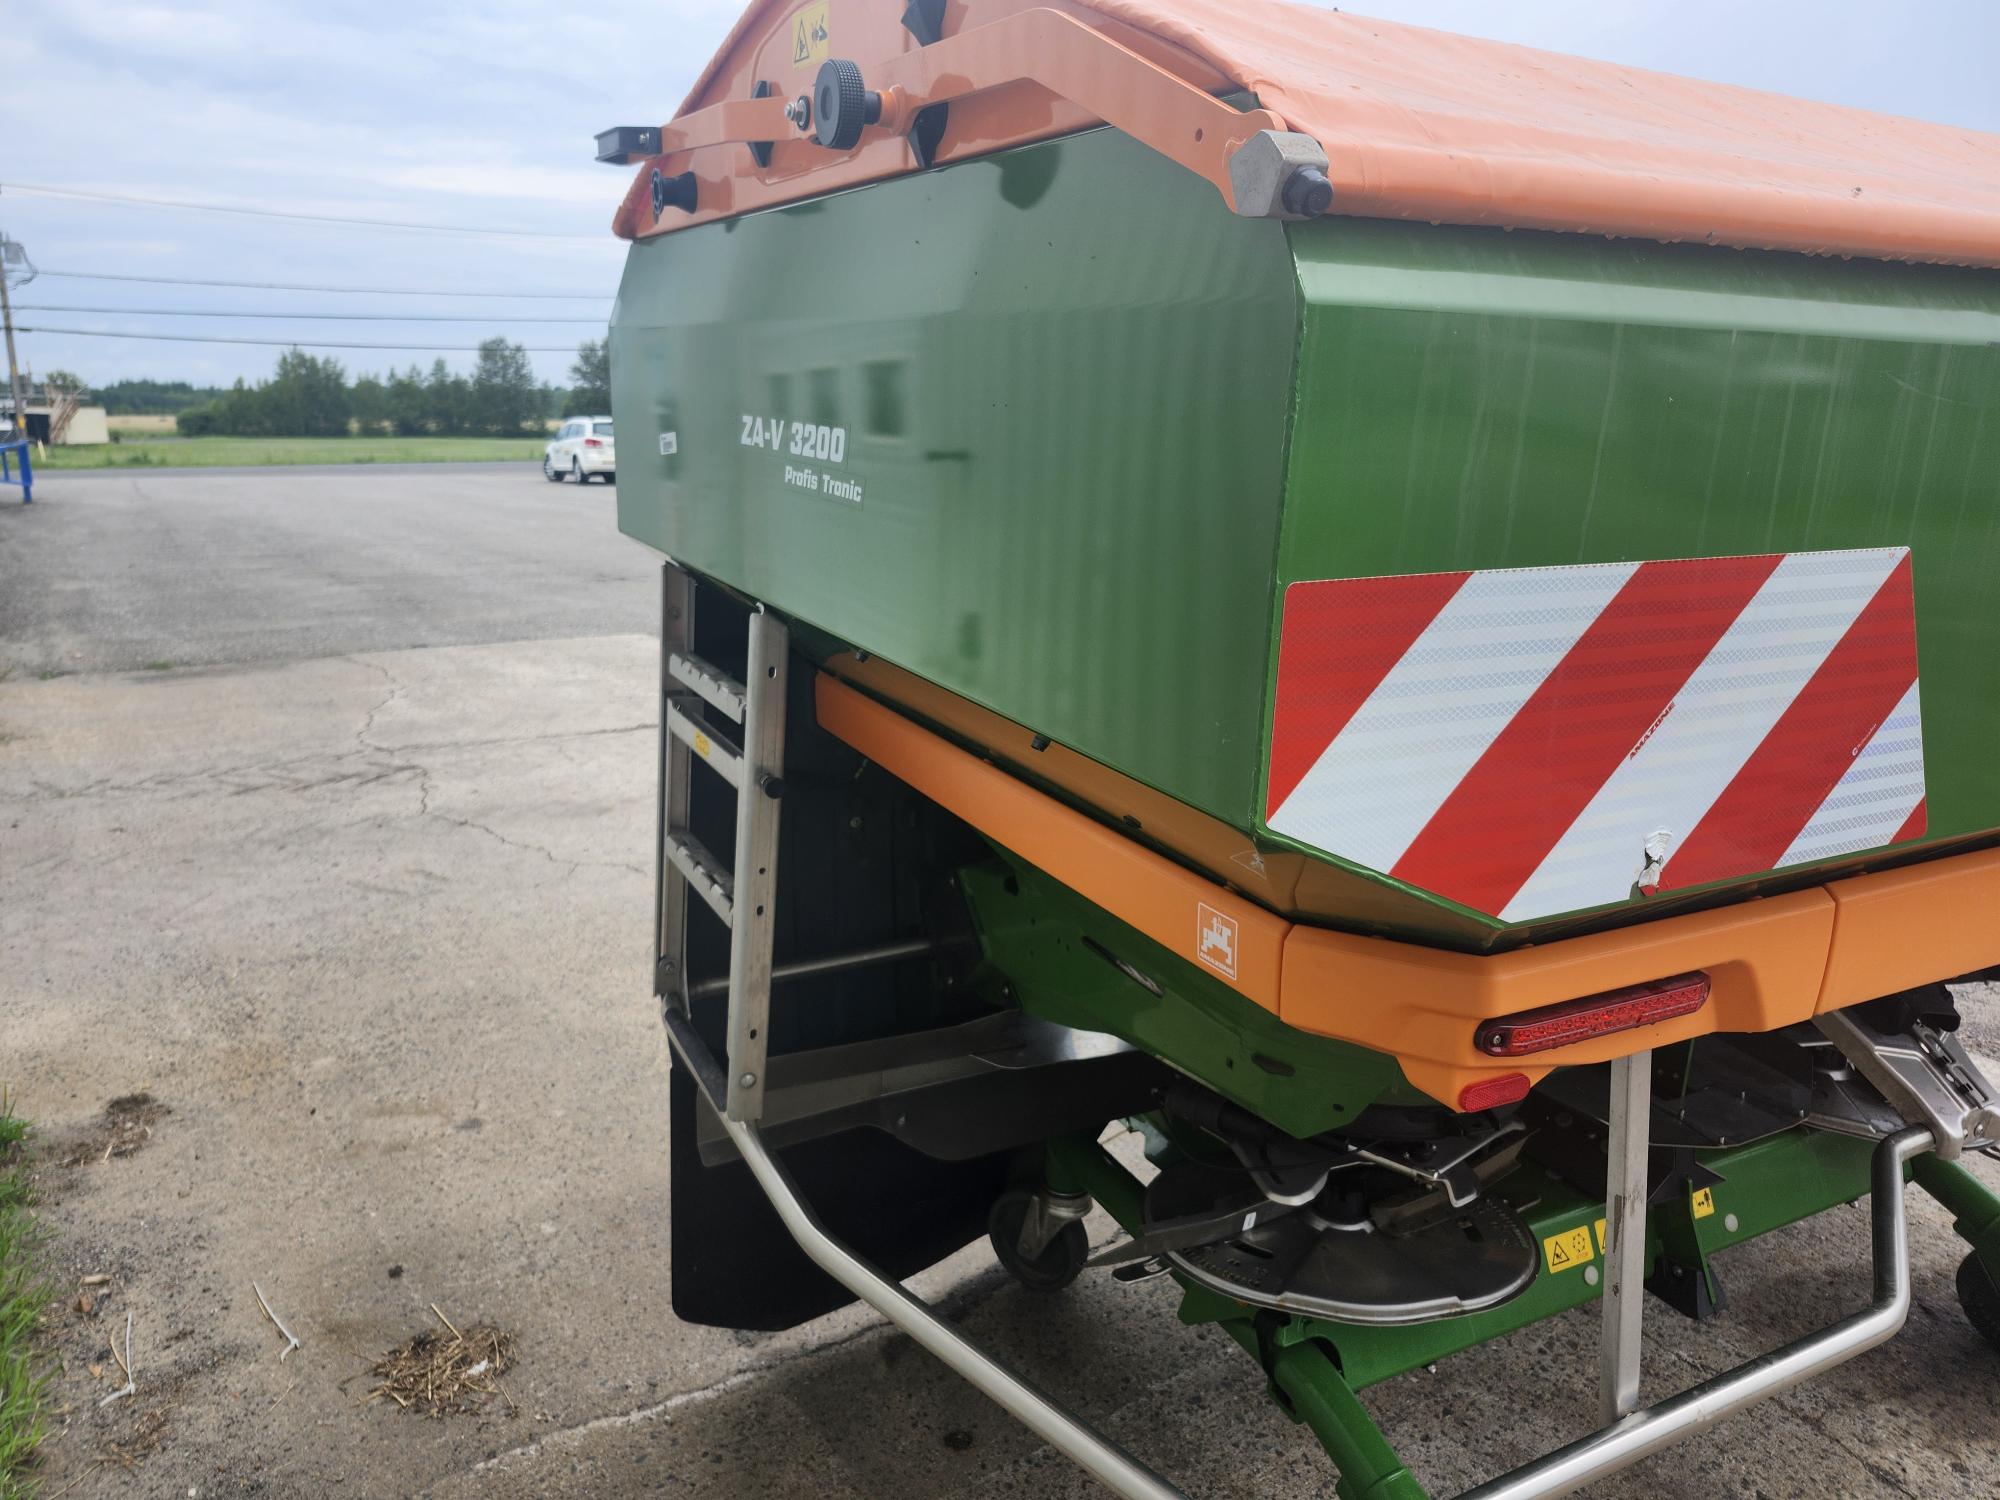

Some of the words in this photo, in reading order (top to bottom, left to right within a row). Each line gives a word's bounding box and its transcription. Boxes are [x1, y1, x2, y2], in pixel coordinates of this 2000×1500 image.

[741, 415, 784, 451] ZA-V
[790, 421, 846, 463] 3200
[784, 465, 818, 490] Profis
[823, 474, 862, 502] Tronic
[1629, 701, 1676, 760] AMAZONE
